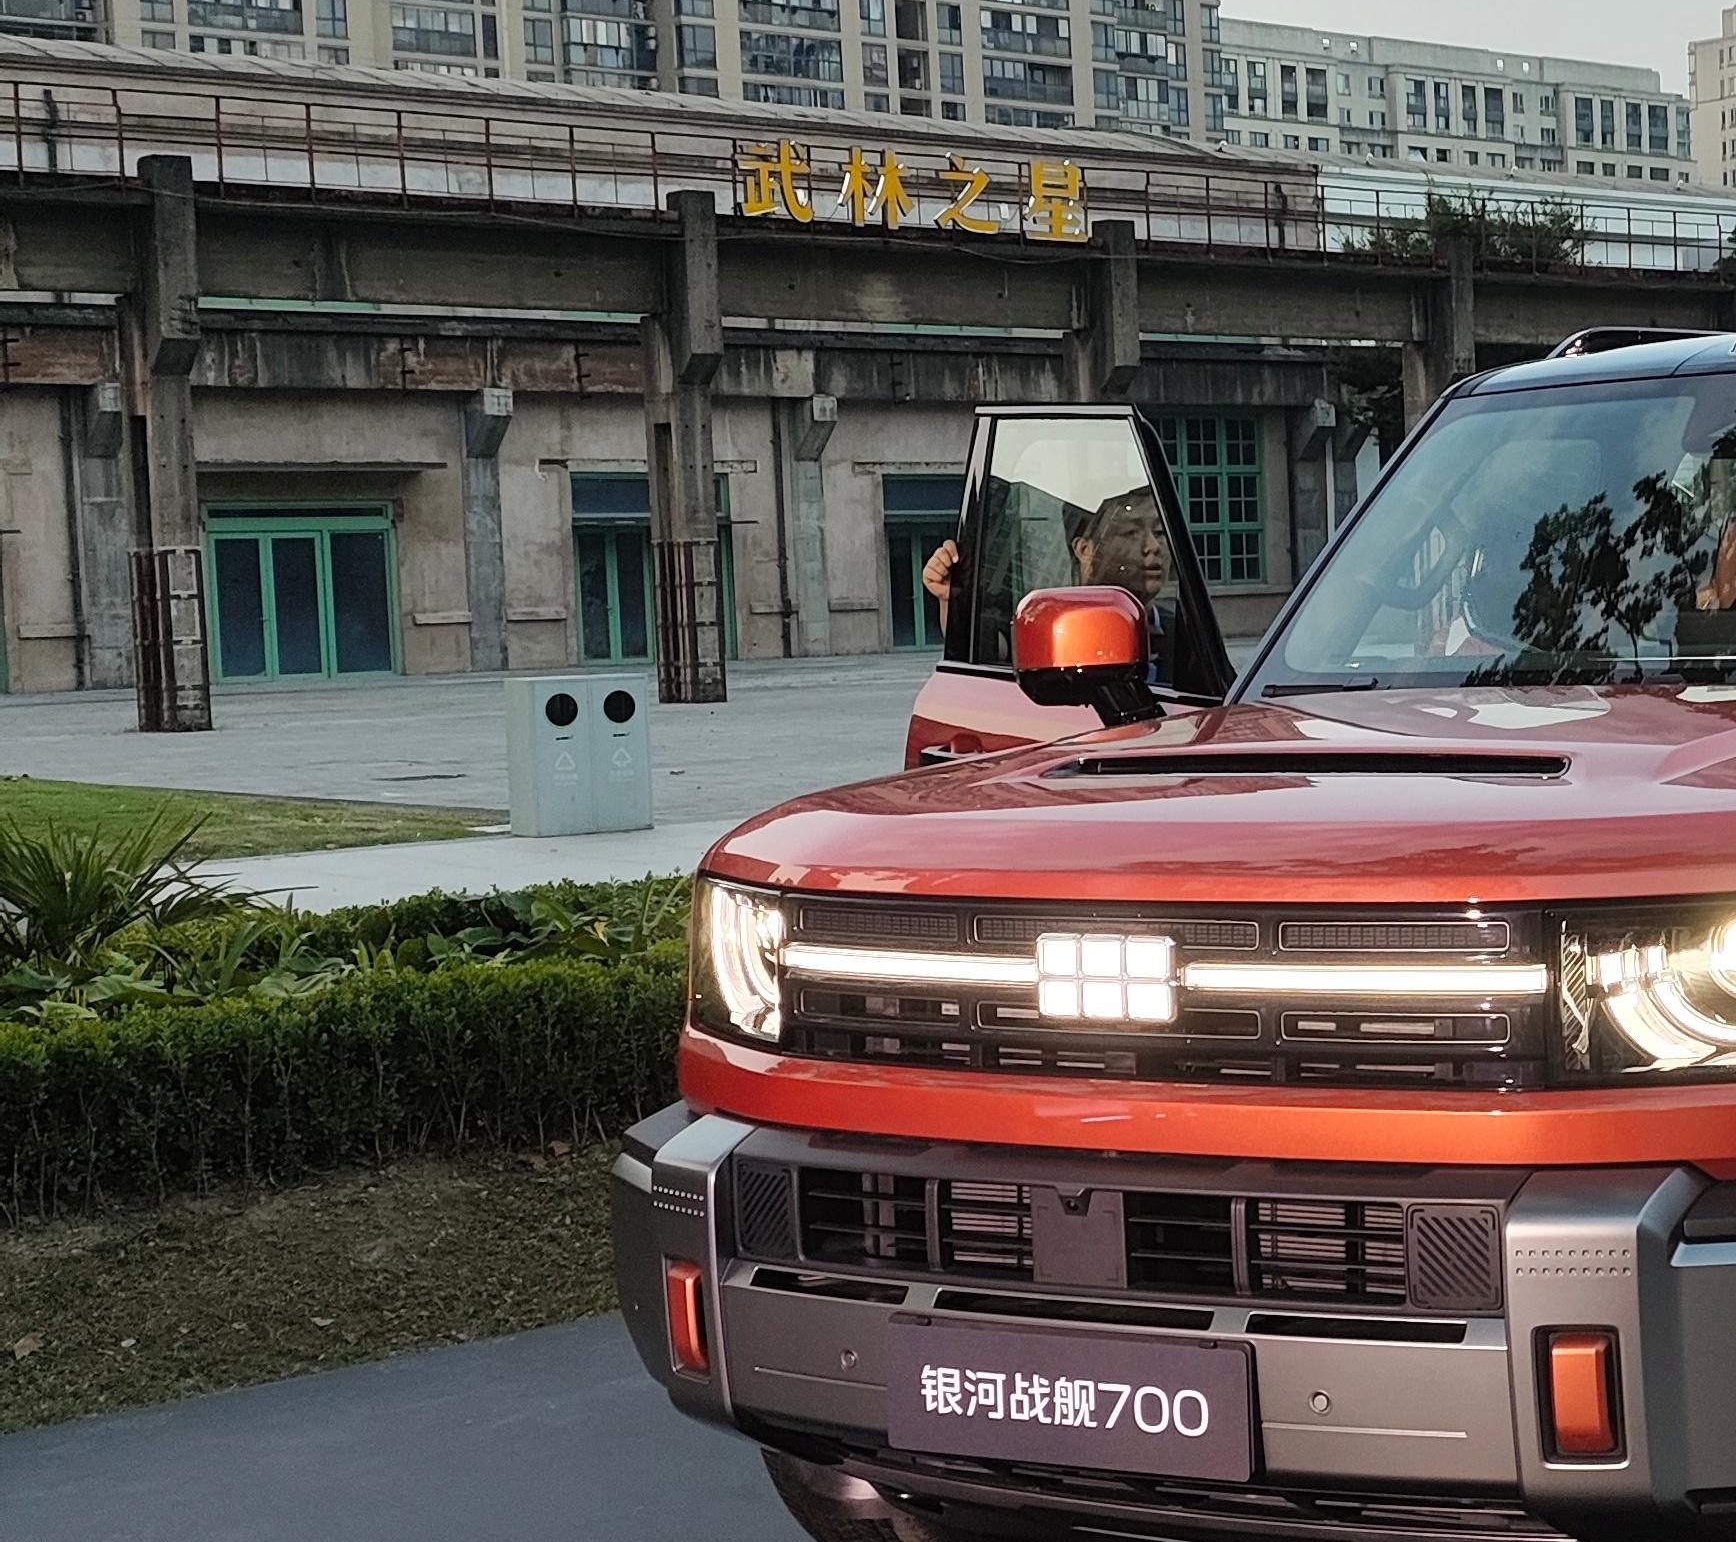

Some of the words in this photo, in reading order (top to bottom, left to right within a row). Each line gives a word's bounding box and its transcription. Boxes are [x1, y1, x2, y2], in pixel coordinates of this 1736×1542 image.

[733, 139, 1092, 243] 武林之星
[920, 1364, 1210, 1438] 银河战舰700
